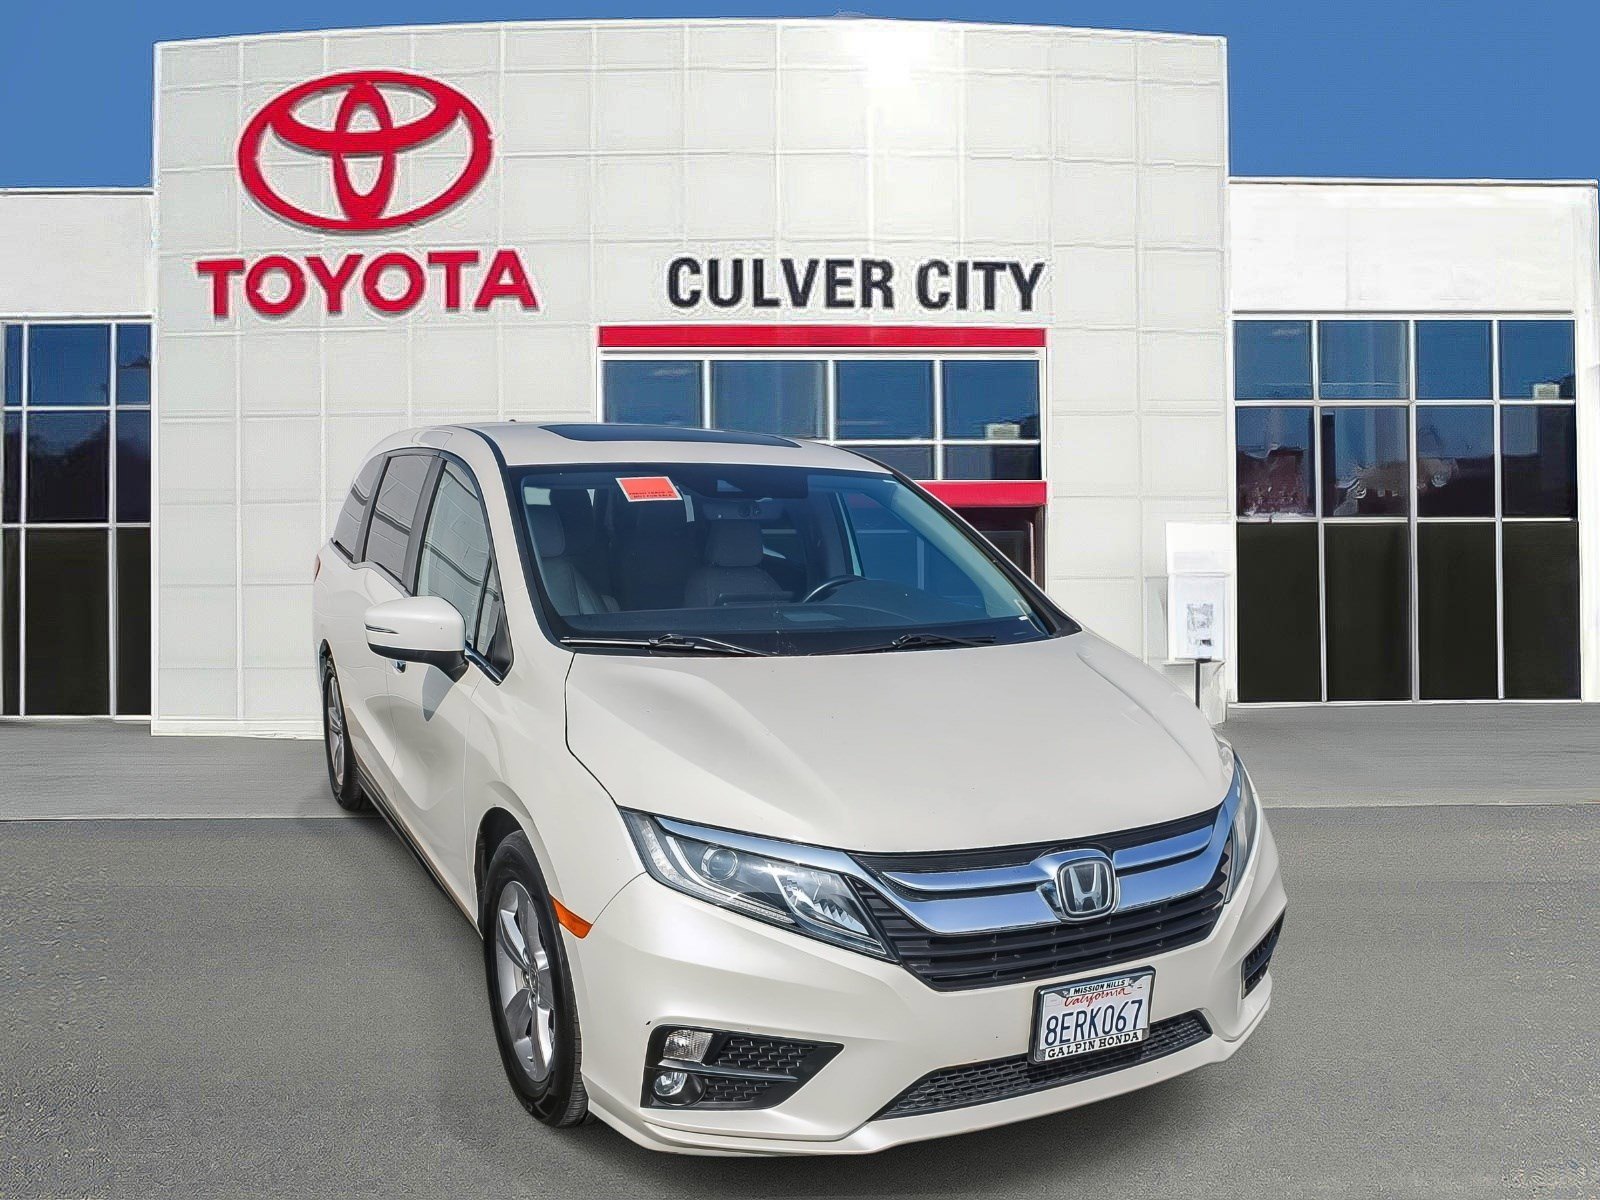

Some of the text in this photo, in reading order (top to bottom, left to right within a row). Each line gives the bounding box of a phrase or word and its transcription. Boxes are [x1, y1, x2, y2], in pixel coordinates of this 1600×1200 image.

[196, 250, 537, 317] TOYOTA
[668, 258, 1045, 311] CULVER CITY
[1064, 988, 1132, 1007] California
[1073, 979, 1126, 995] MISSION HILLS
[1044, 999, 1143, 1046] 8ERK067
[1047, 1031, 1139, 1059] GALPIN HONDA
